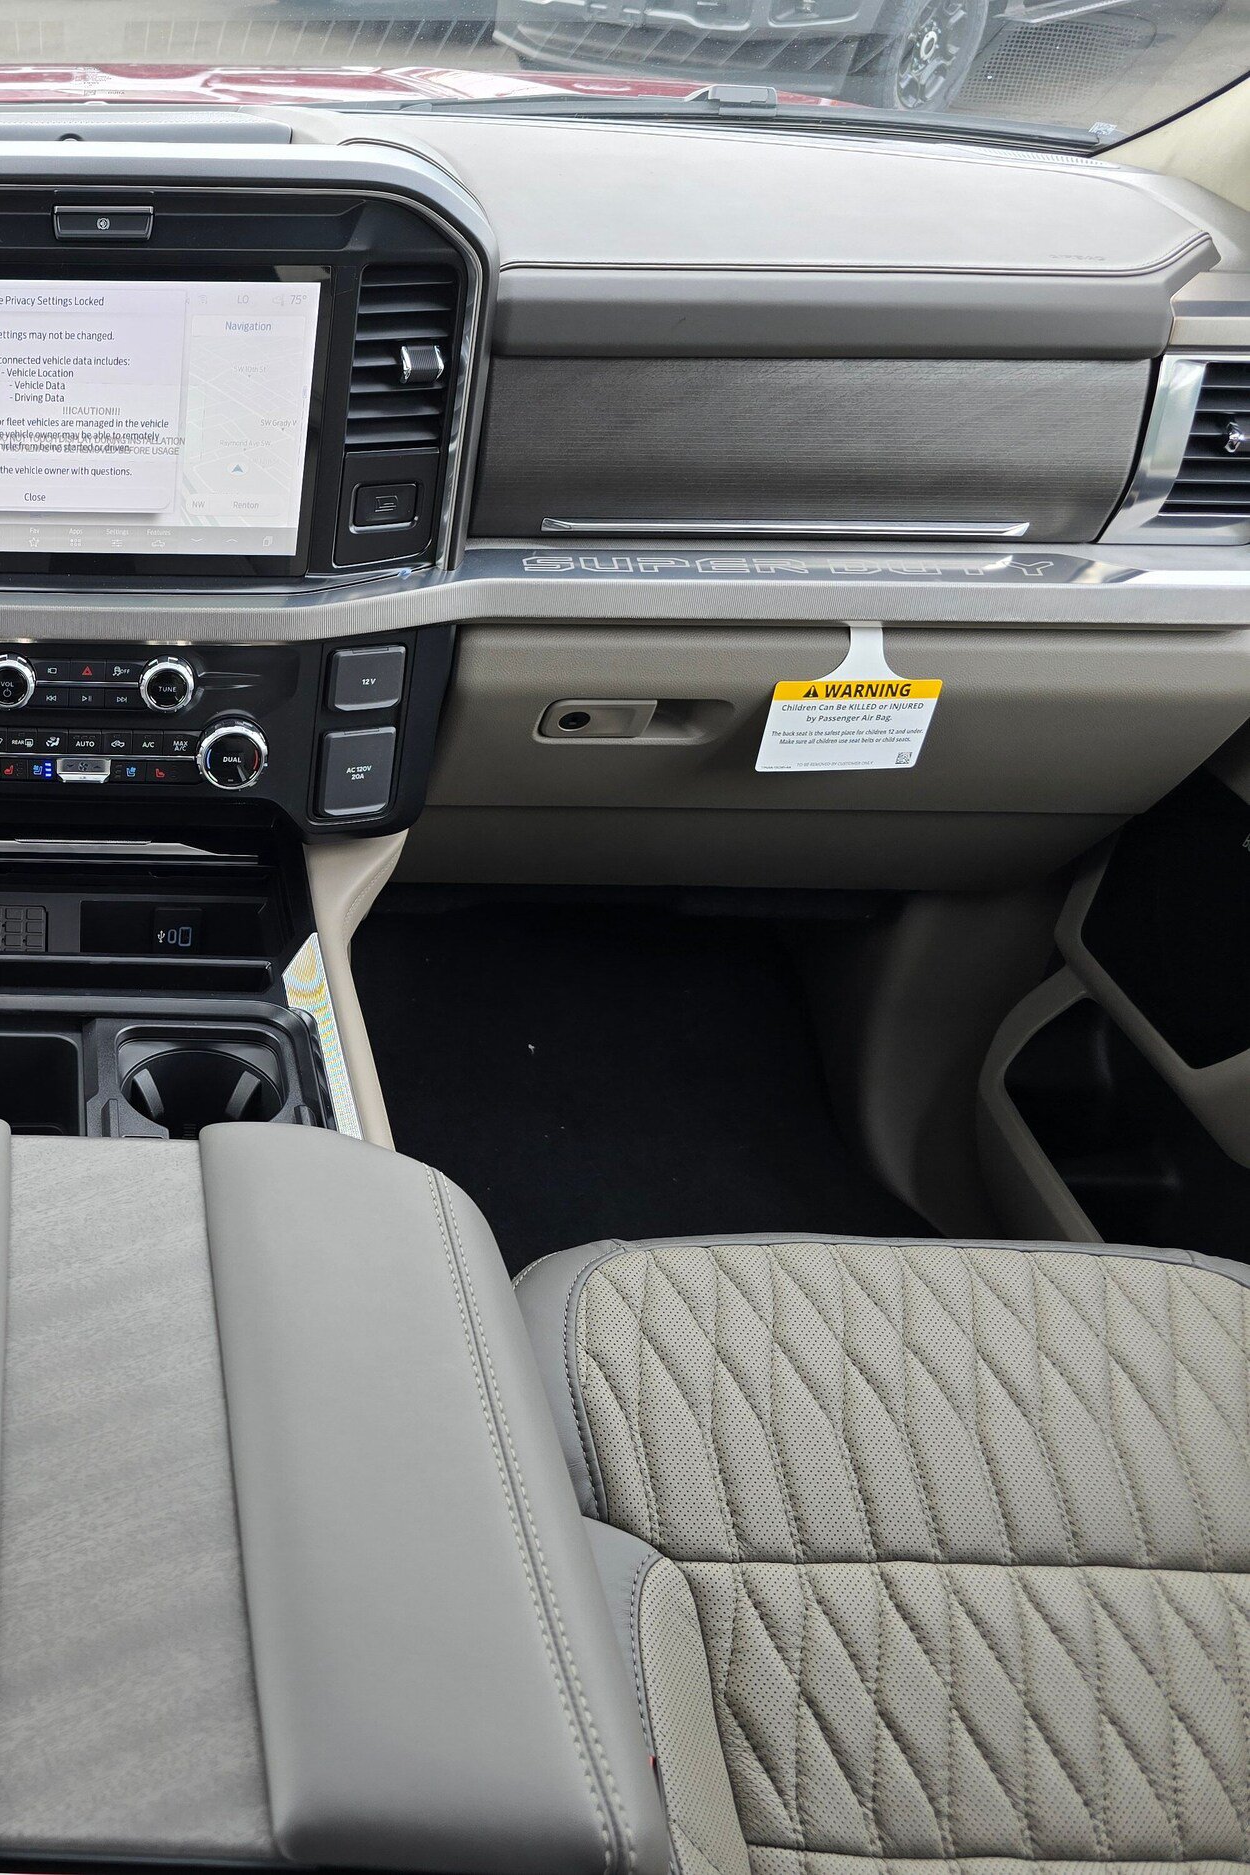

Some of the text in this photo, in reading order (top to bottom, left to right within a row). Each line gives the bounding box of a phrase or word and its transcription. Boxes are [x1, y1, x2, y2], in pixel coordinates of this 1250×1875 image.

[5, 296, 35, 307] Privacy
[37, 296, 72, 307] Settings
[74, 296, 104, 306] Locked
[225, 321, 272, 332] Navigation
[28, 332, 47, 341] may
[48, 331, 63, 340] not
[65, 331, 76, 340] be
[76, 331, 115, 341] changed.
[42, 355, 71, 365] vehicle
[72, 356, 92, 366] data
[93, 356, 130, 366] includes:
[6, 368, 74, 378] Vehicle Location
[14, 380, 65, 390] Vehicle Data
[14, 393, 65, 404] Driving Data
[6, 417, 26, 427] fleet
[27, 417, 59, 427] vehicles
[60, 419, 74, 428] are
[75, 418, 114, 430] managed
[115, 418, 123, 428] in
[125, 418, 139, 428] the
[140, 418, 169, 429] vehicle
[272, 419, 290, 428] Grady
[5, 429, 34, 440] vehicle
[34, 431, 61, 440] owner
[62, 431, 80, 442] may
[81, 429, 92, 440] be
[93, 429, 110, 440] able
[112, 430, 121, 440] to
[122, 430, 160, 441] remotely
[127, 437, 186, 446] INSTALLATION
[152, 447, 180, 455] USAGE
[0, 466, 13, 475] the
[14, 466, 43, 475] vehicle
[44, 467, 70, 476] owner
[71, 466, 89, 476] with
[90, 467, 132, 478] questions.
[24, 492, 46, 502] Close
[233, 501, 259, 509] Renton
[522, 556, 1054, 577] SUPER DUTY
[824, 683, 912, 698] WARNING
[889, 702, 924, 711] INJURED
[806, 715, 816, 723] by
[818, 715, 860, 723] Passenger
[875, 714, 893, 723] Bag.
[356, 765, 372, 773] 120V
